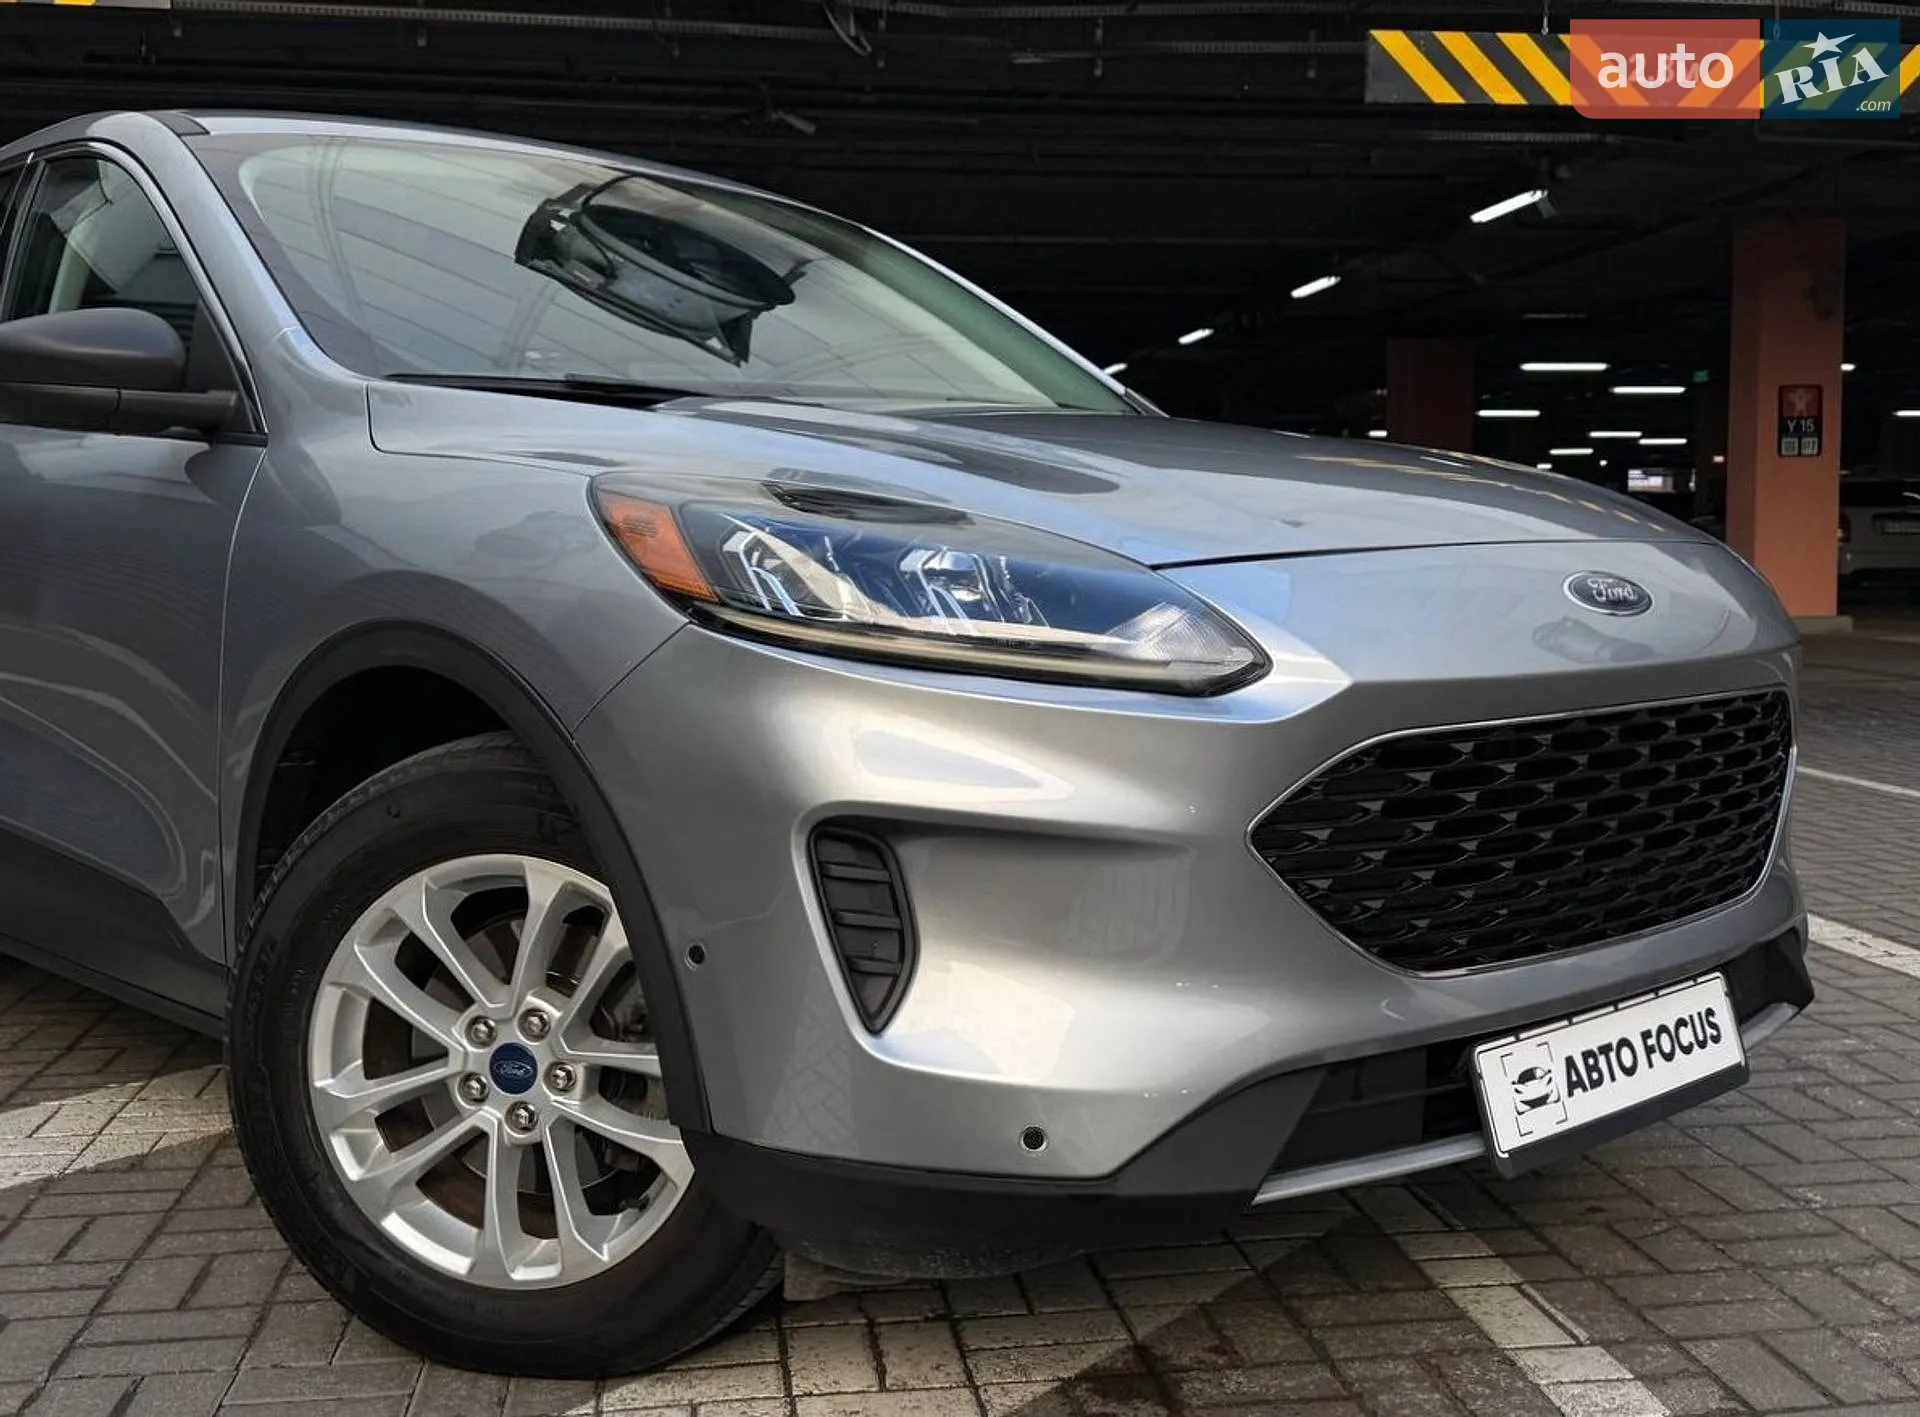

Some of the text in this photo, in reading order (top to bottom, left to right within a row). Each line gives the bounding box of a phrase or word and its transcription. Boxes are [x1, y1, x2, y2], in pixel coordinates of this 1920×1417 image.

[1587, 577, 1638, 602] Ford
[1563, 1006, 1723, 1099] АВТО FOCUS
